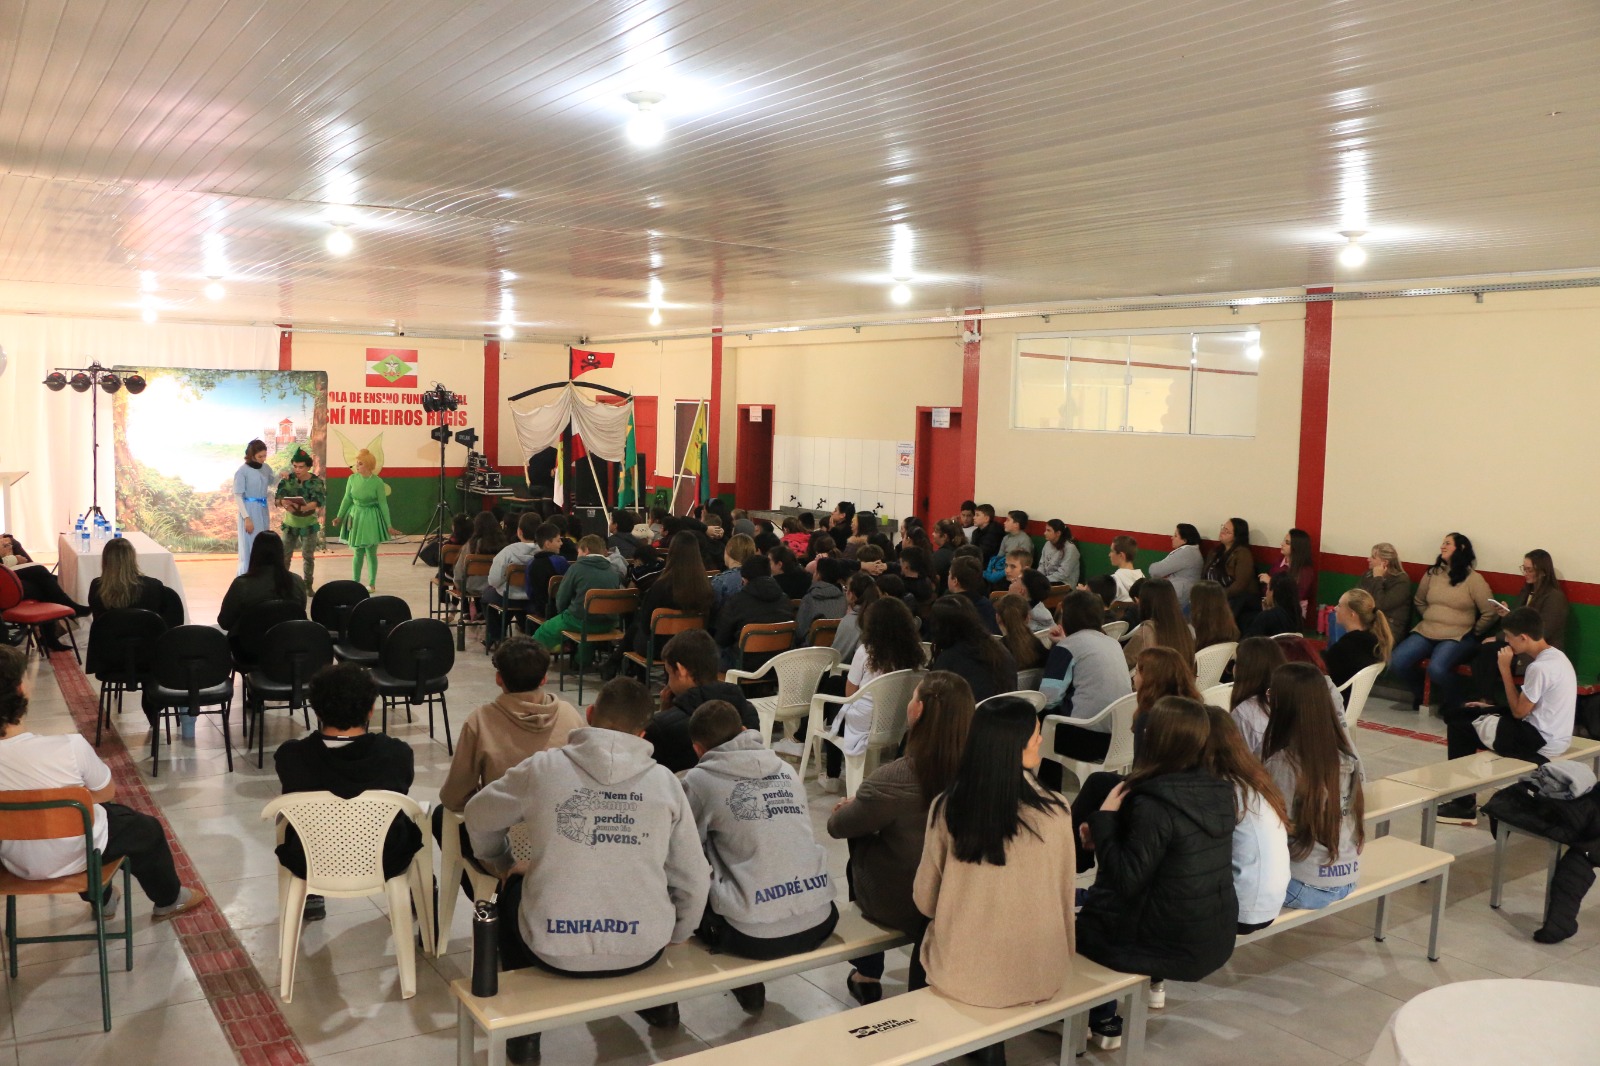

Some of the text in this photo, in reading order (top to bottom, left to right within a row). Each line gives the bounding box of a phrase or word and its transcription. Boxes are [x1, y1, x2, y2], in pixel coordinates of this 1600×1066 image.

[349, 392, 362, 403] DE
[364, 392, 399, 404] ENSINO
[349, 408, 423, 426] MEDEIROS
[629, 792, 643, 802] foi
[762, 790, 794, 801] perdido
[594, 814, 635, 825] perdido
[1318, 863, 1352, 877] EMILY
[755, 876, 803, 904] ANDRÉ
[546, 918, 640, 935] LENHARDT
[872, 1019, 899, 1030] SANTA
[877, 1018, 917, 1032] CATARINA
